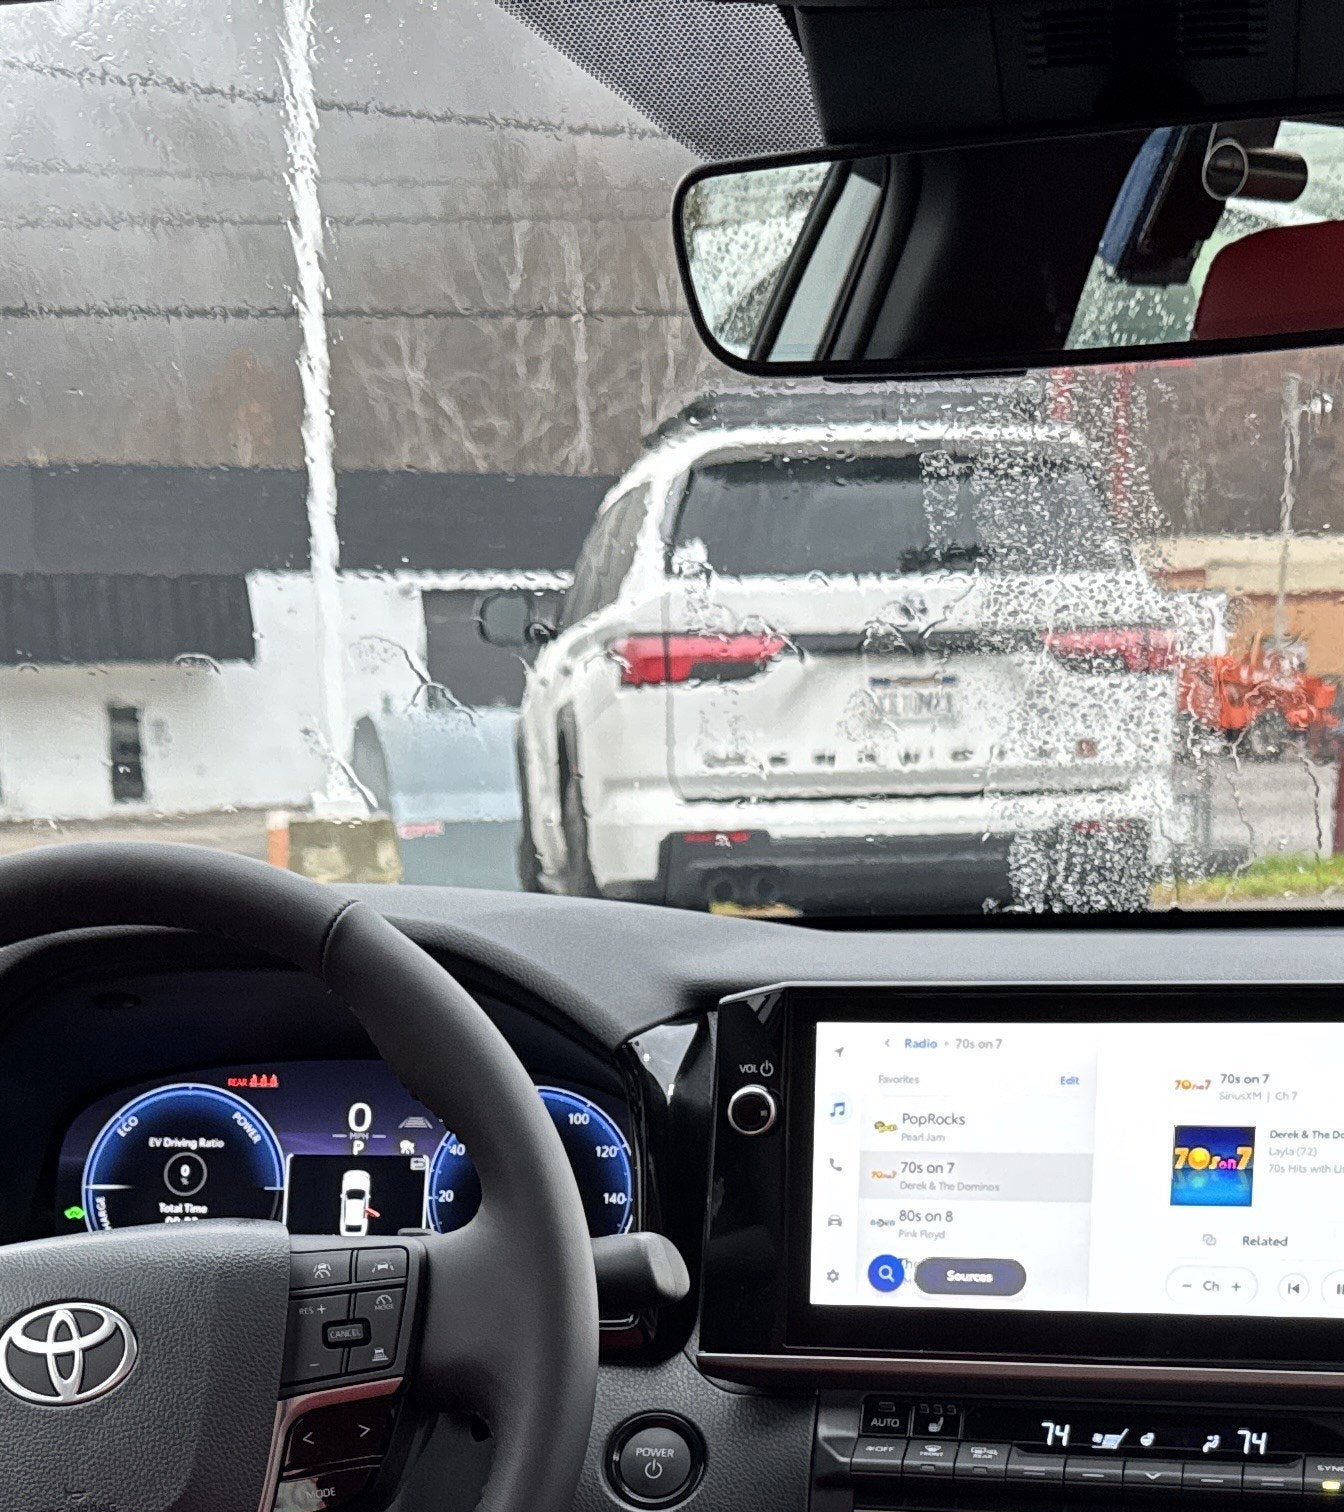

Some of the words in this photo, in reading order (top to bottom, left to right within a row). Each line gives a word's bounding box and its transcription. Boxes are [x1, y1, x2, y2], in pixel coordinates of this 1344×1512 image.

[904, 1038, 938, 1049] Radio
[955, 1038, 976, 1049] 70s
[978, 1040, 993, 1049] on
[995, 1038, 1003, 1049] 7
[739, 1063, 758, 1074] VOL
[878, 1074, 920, 1084] Favorites
[1060, 1076, 1080, 1085] Edit
[1220, 1073, 1241, 1084] 70s
[1243, 1076, 1260, 1084] on
[1262, 1073, 1270, 1084] 7
[1219, 1091, 1262, 1101] SiriusXM
[1274, 1091, 1289, 1101] Ch
[1290, 1091, 1298, 1101] 7
[347, 1102, 373, 1133] 0
[568, 1113, 590, 1125] 100
[902, 1112, 966, 1127] PopRocks
[116, 1115, 139, 1138] ECO
[231, 1111, 263, 1144] POWER
[349, 1132, 370, 1140] MPH
[900, 1132, 924, 1142] Pearl
[926, 1132, 946, 1142] Jam
[1269, 1130, 1298, 1139] Derek
[1301, 1130, 1309, 1139] &
[1312, 1130, 1330, 1139] The
[148, 1137, 163, 1148] EV
[163, 1137, 197, 1150] Driving
[199, 1137, 225, 1149] Ratio
[352, 1140, 365, 1156] P
[449, 1143, 466, 1156] 40
[596, 1146, 617, 1158] 120
[1269, 1147, 1294, 1157] Layla
[1296, 1147, 1318, 1157] (72)
[180, 1164, 190, 1177] 0
[900, 1161, 924, 1174] 70s
[926, 1164, 944, 1174] on
[946, 1161, 955, 1174] 7
[1269, 1164, 1286, 1174] 70s
[1288, 1164, 1308, 1174] Hits
[1310, 1164, 1331, 1174] with
[899, 1182, 927, 1191] Derek
[939, 1182, 956, 1191] The
[957, 1182, 1001, 1192] Dominos
[438, 1190, 454, 1203] 20
[603, 1192, 627, 1205] 140
[158, 1202, 183, 1213] Total
[184, 1202, 208, 1214] Time
[898, 1210, 922, 1222] 80s
[924, 1212, 942, 1222] on
[945, 1210, 954, 1222] 8
[898, 1230, 918, 1239] Pink
[919, 1230, 946, 1240] Floyd
[1242, 1236, 1289, 1247] Related
[946, 1270, 994, 1283] Sources
[1202, 1280, 1220, 1292] Ch
[329, 1328, 362, 1339] CANCEL
[870, 1417, 900, 1428] AUTO
[1041, 1420, 1071, 1447] 74
[1237, 1428, 1268, 1456] 74
[636, 1447, 675, 1458] POWER
[305, 1486, 337, 1499] MODE
